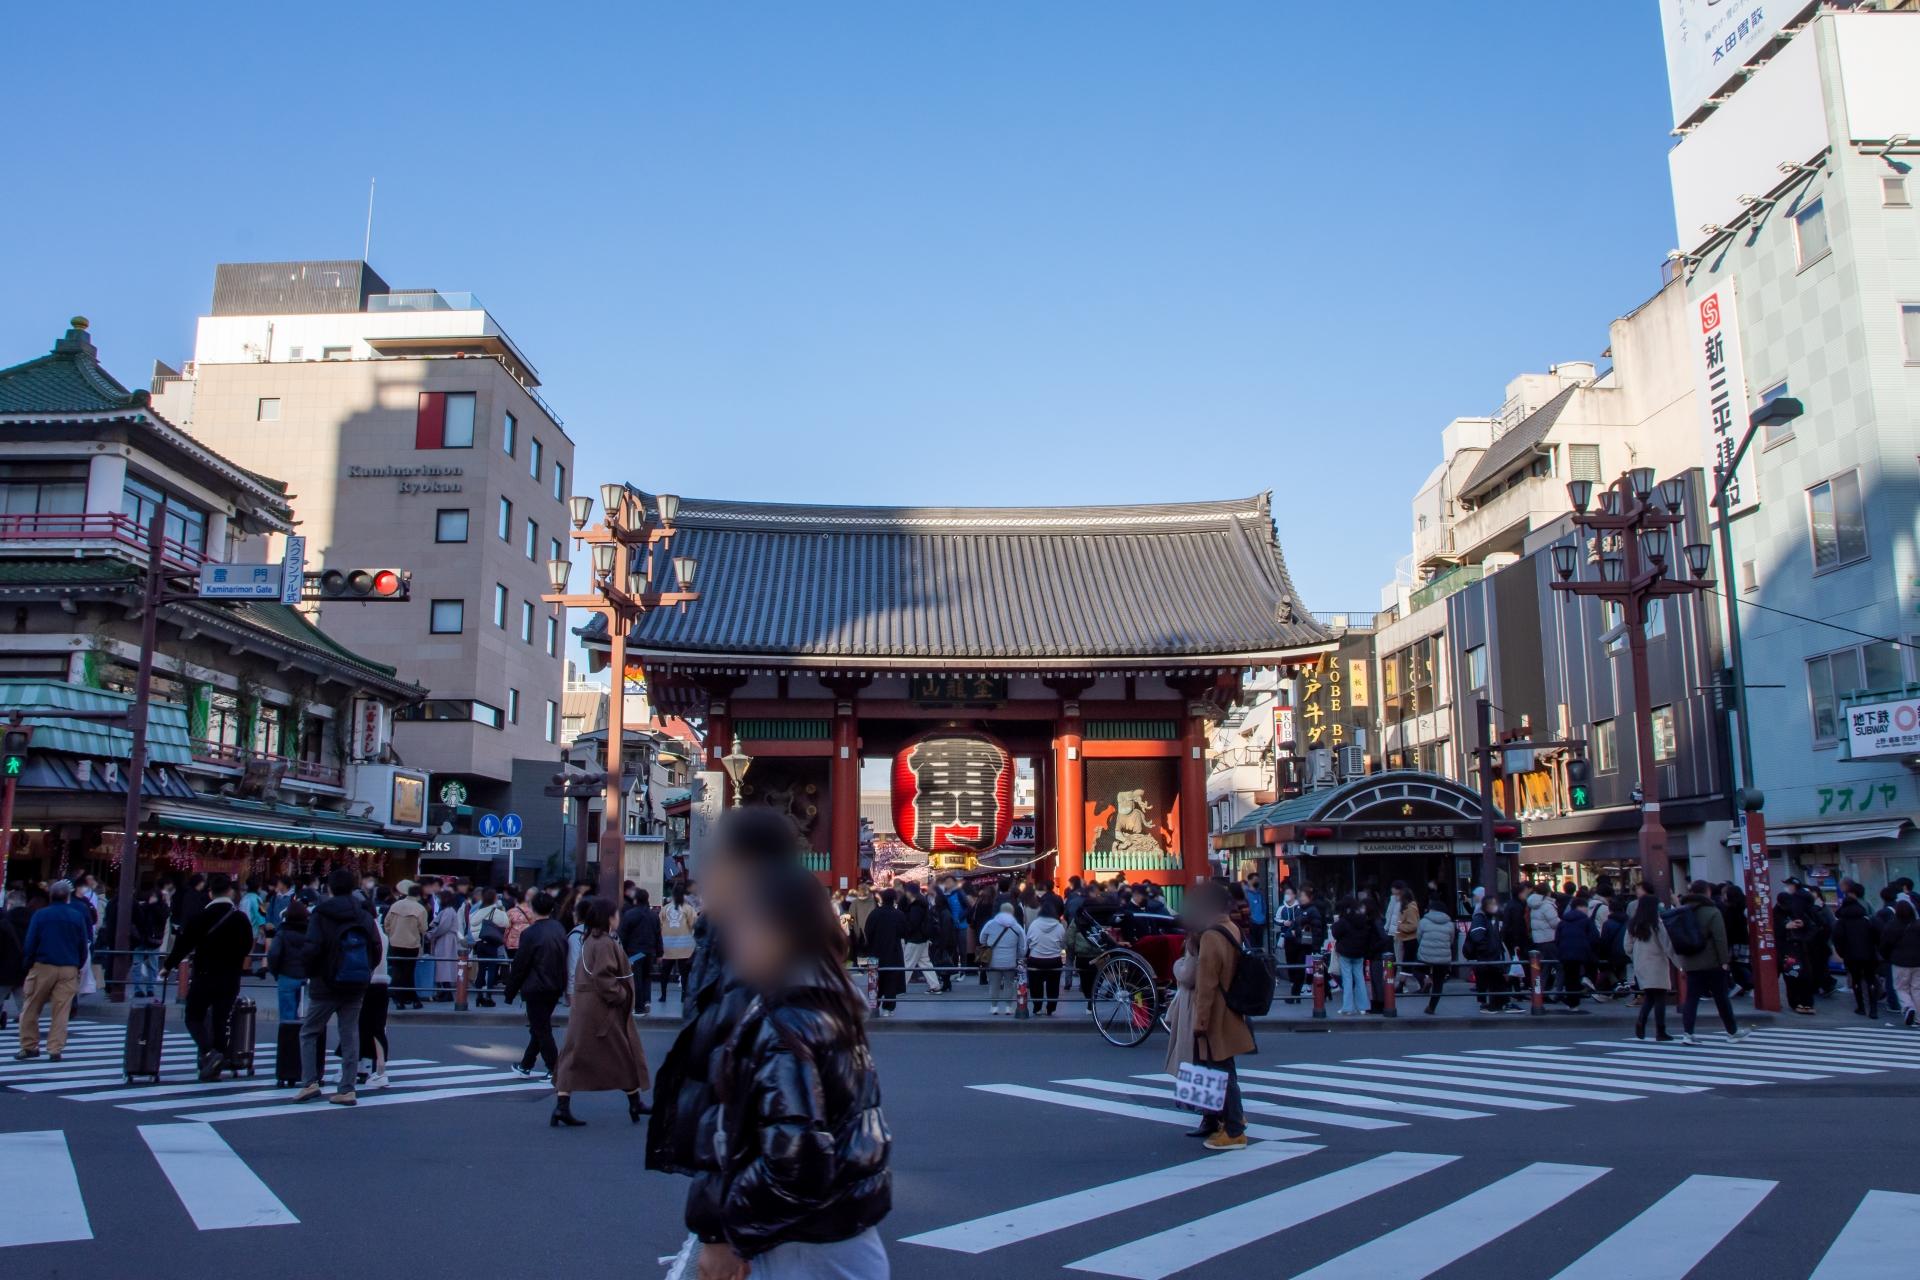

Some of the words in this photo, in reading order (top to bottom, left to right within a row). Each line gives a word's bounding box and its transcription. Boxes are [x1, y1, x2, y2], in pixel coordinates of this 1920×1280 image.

[1712, 6, 1764, 66] 太田胃散
[348, 465, 463, 478] Kaminarimon
[398, 481, 463, 497] Ryokan
[214, 569, 268, 583] 雷門
[286, 539, 302, 602] スクランブル式
[207, 586, 253, 594] Kaminarimon
[256, 586, 272, 594] Gate
[1853, 709, 1890, 728] 地下鉄
[1855, 725, 1890, 737] SUBWAY
[906, 738, 1004, 851] 雷門
[1817, 782, 1897, 815] アオノヤ
[1363, 844, 1416, 852] KAMINARIMON
[1419, 843, 1444, 851] KOBAN
